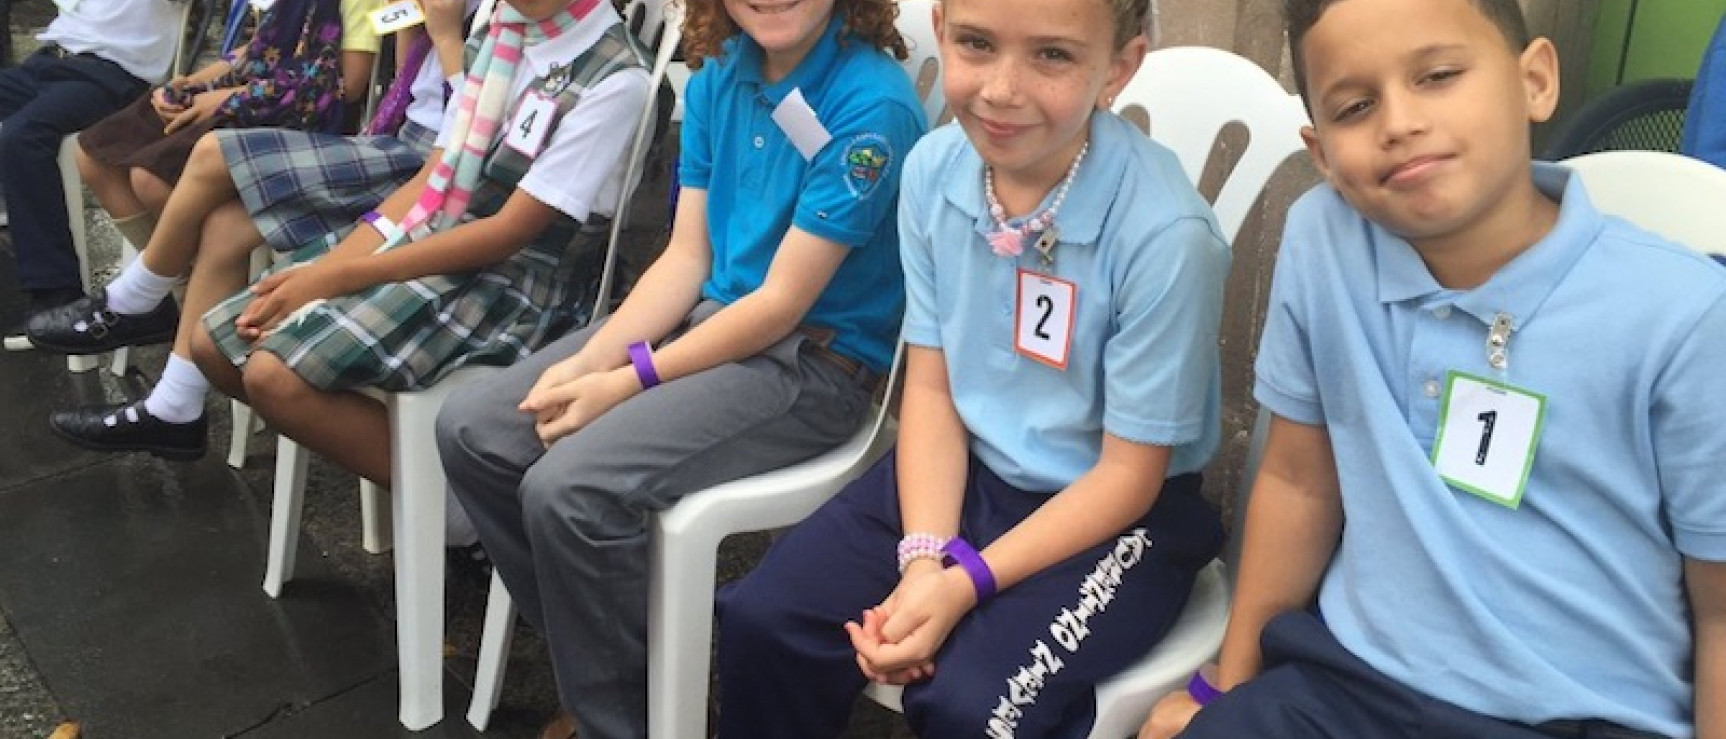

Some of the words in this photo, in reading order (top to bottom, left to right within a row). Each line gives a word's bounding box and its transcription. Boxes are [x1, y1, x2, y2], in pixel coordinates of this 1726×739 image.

[381, 8, 409, 24] 5
[519, 109, 538, 140] 4
[1034, 294, 1054, 341] 2
[1475, 410, 1498, 466] 1
